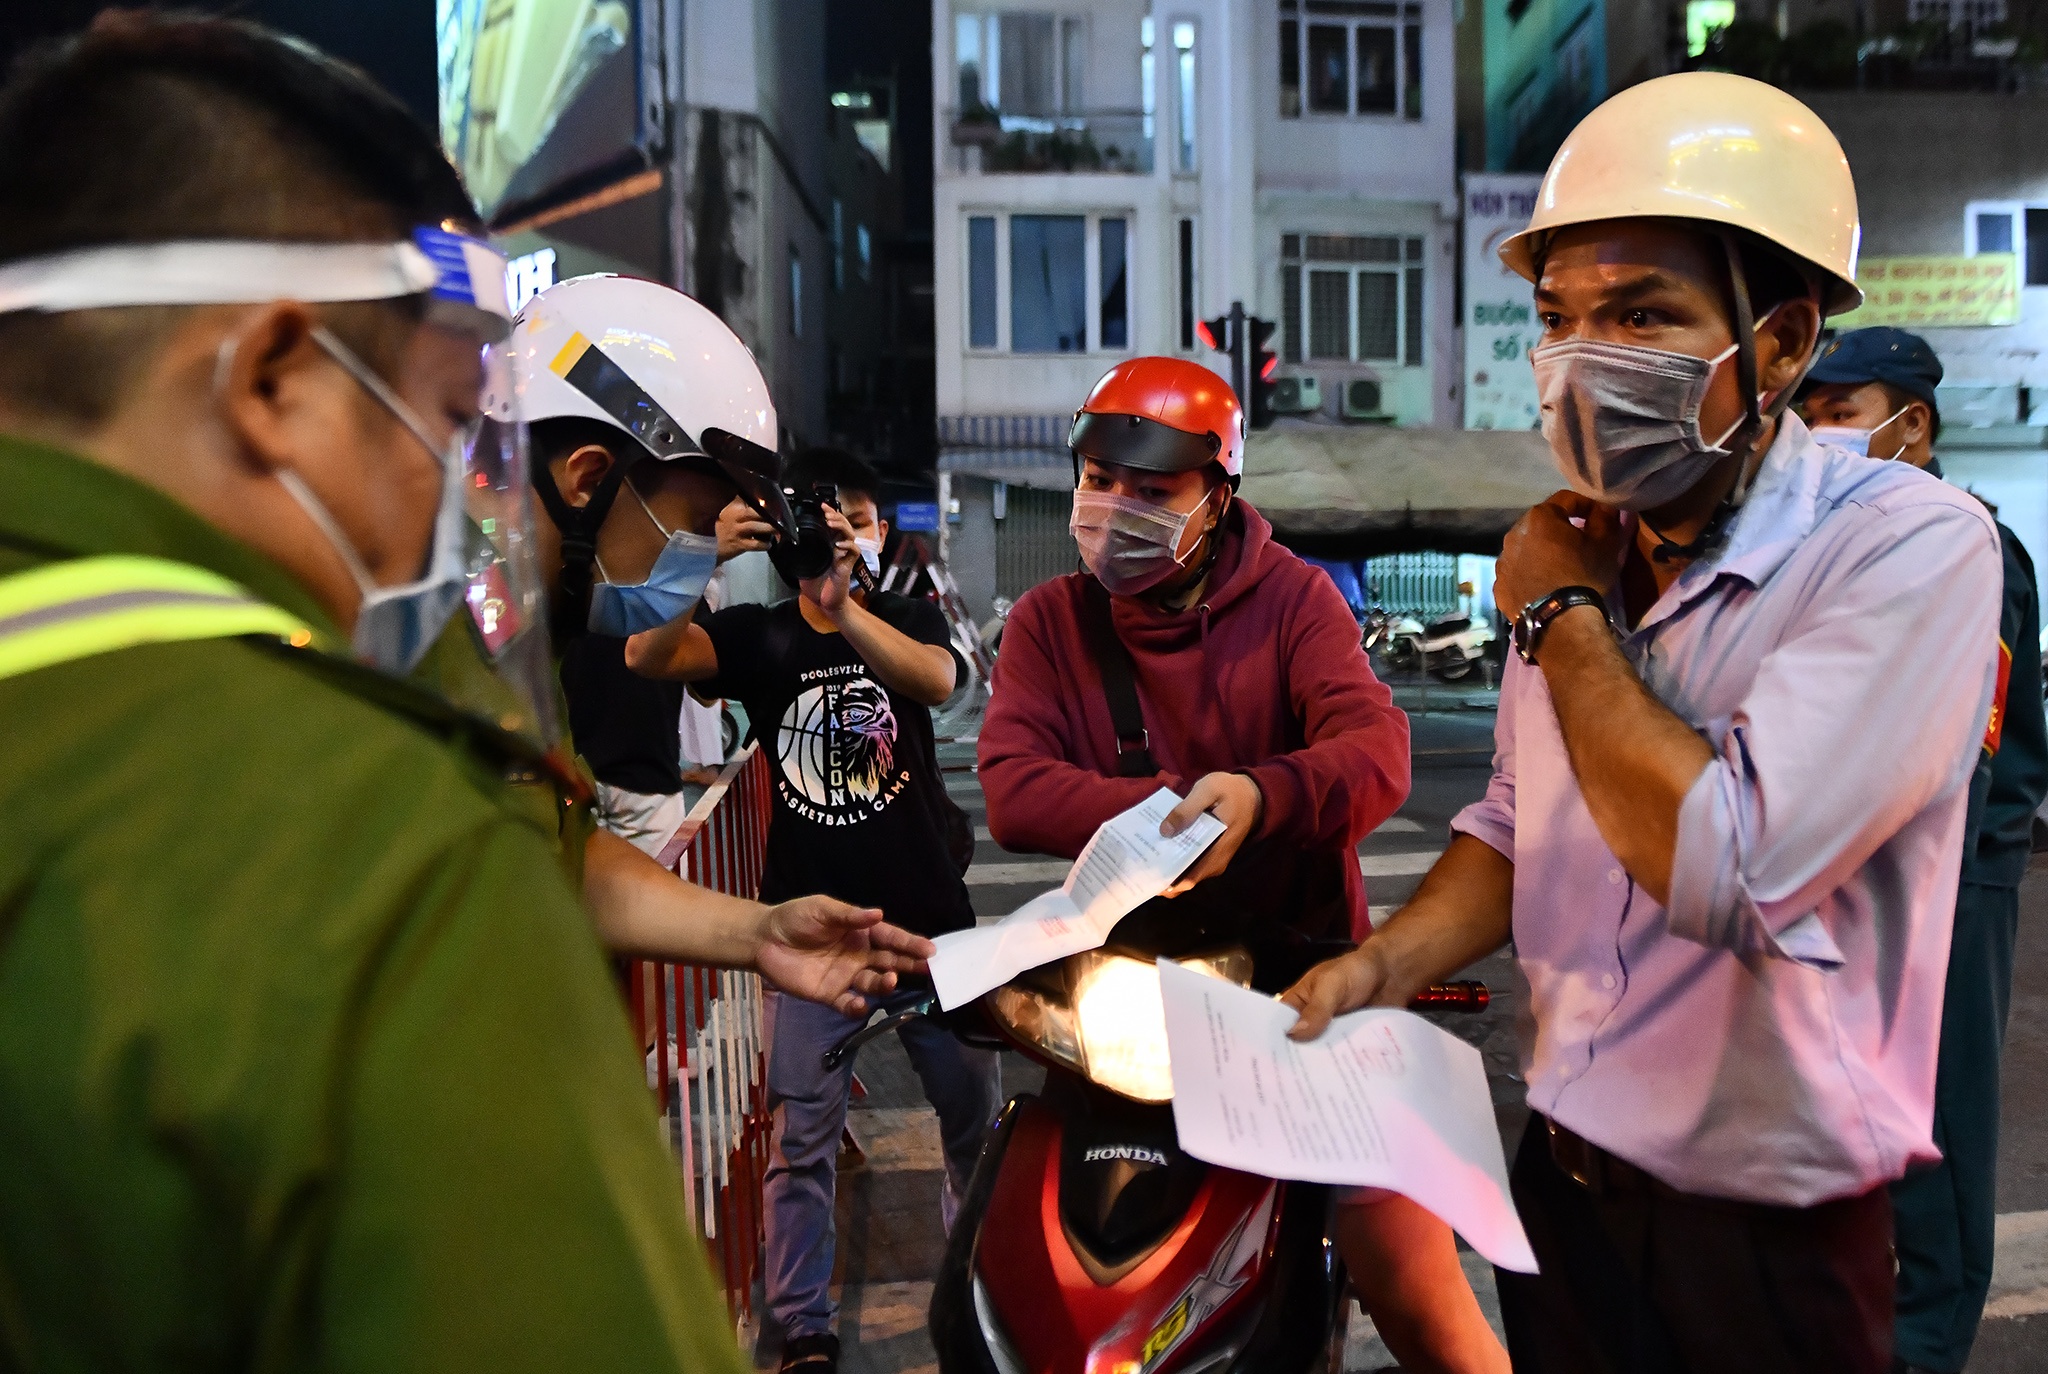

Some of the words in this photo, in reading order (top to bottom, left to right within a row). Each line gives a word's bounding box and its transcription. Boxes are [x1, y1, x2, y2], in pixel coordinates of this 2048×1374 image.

[858, 568, 875, 592] SONY
[800, 664, 865, 682] POOLESVILE
[828, 694, 845, 807] FALCON
[778, 780, 868, 826] BASKETBALL
[873, 770, 911, 812] CAMP
[1083, 1147, 1168, 1167] HONDA
